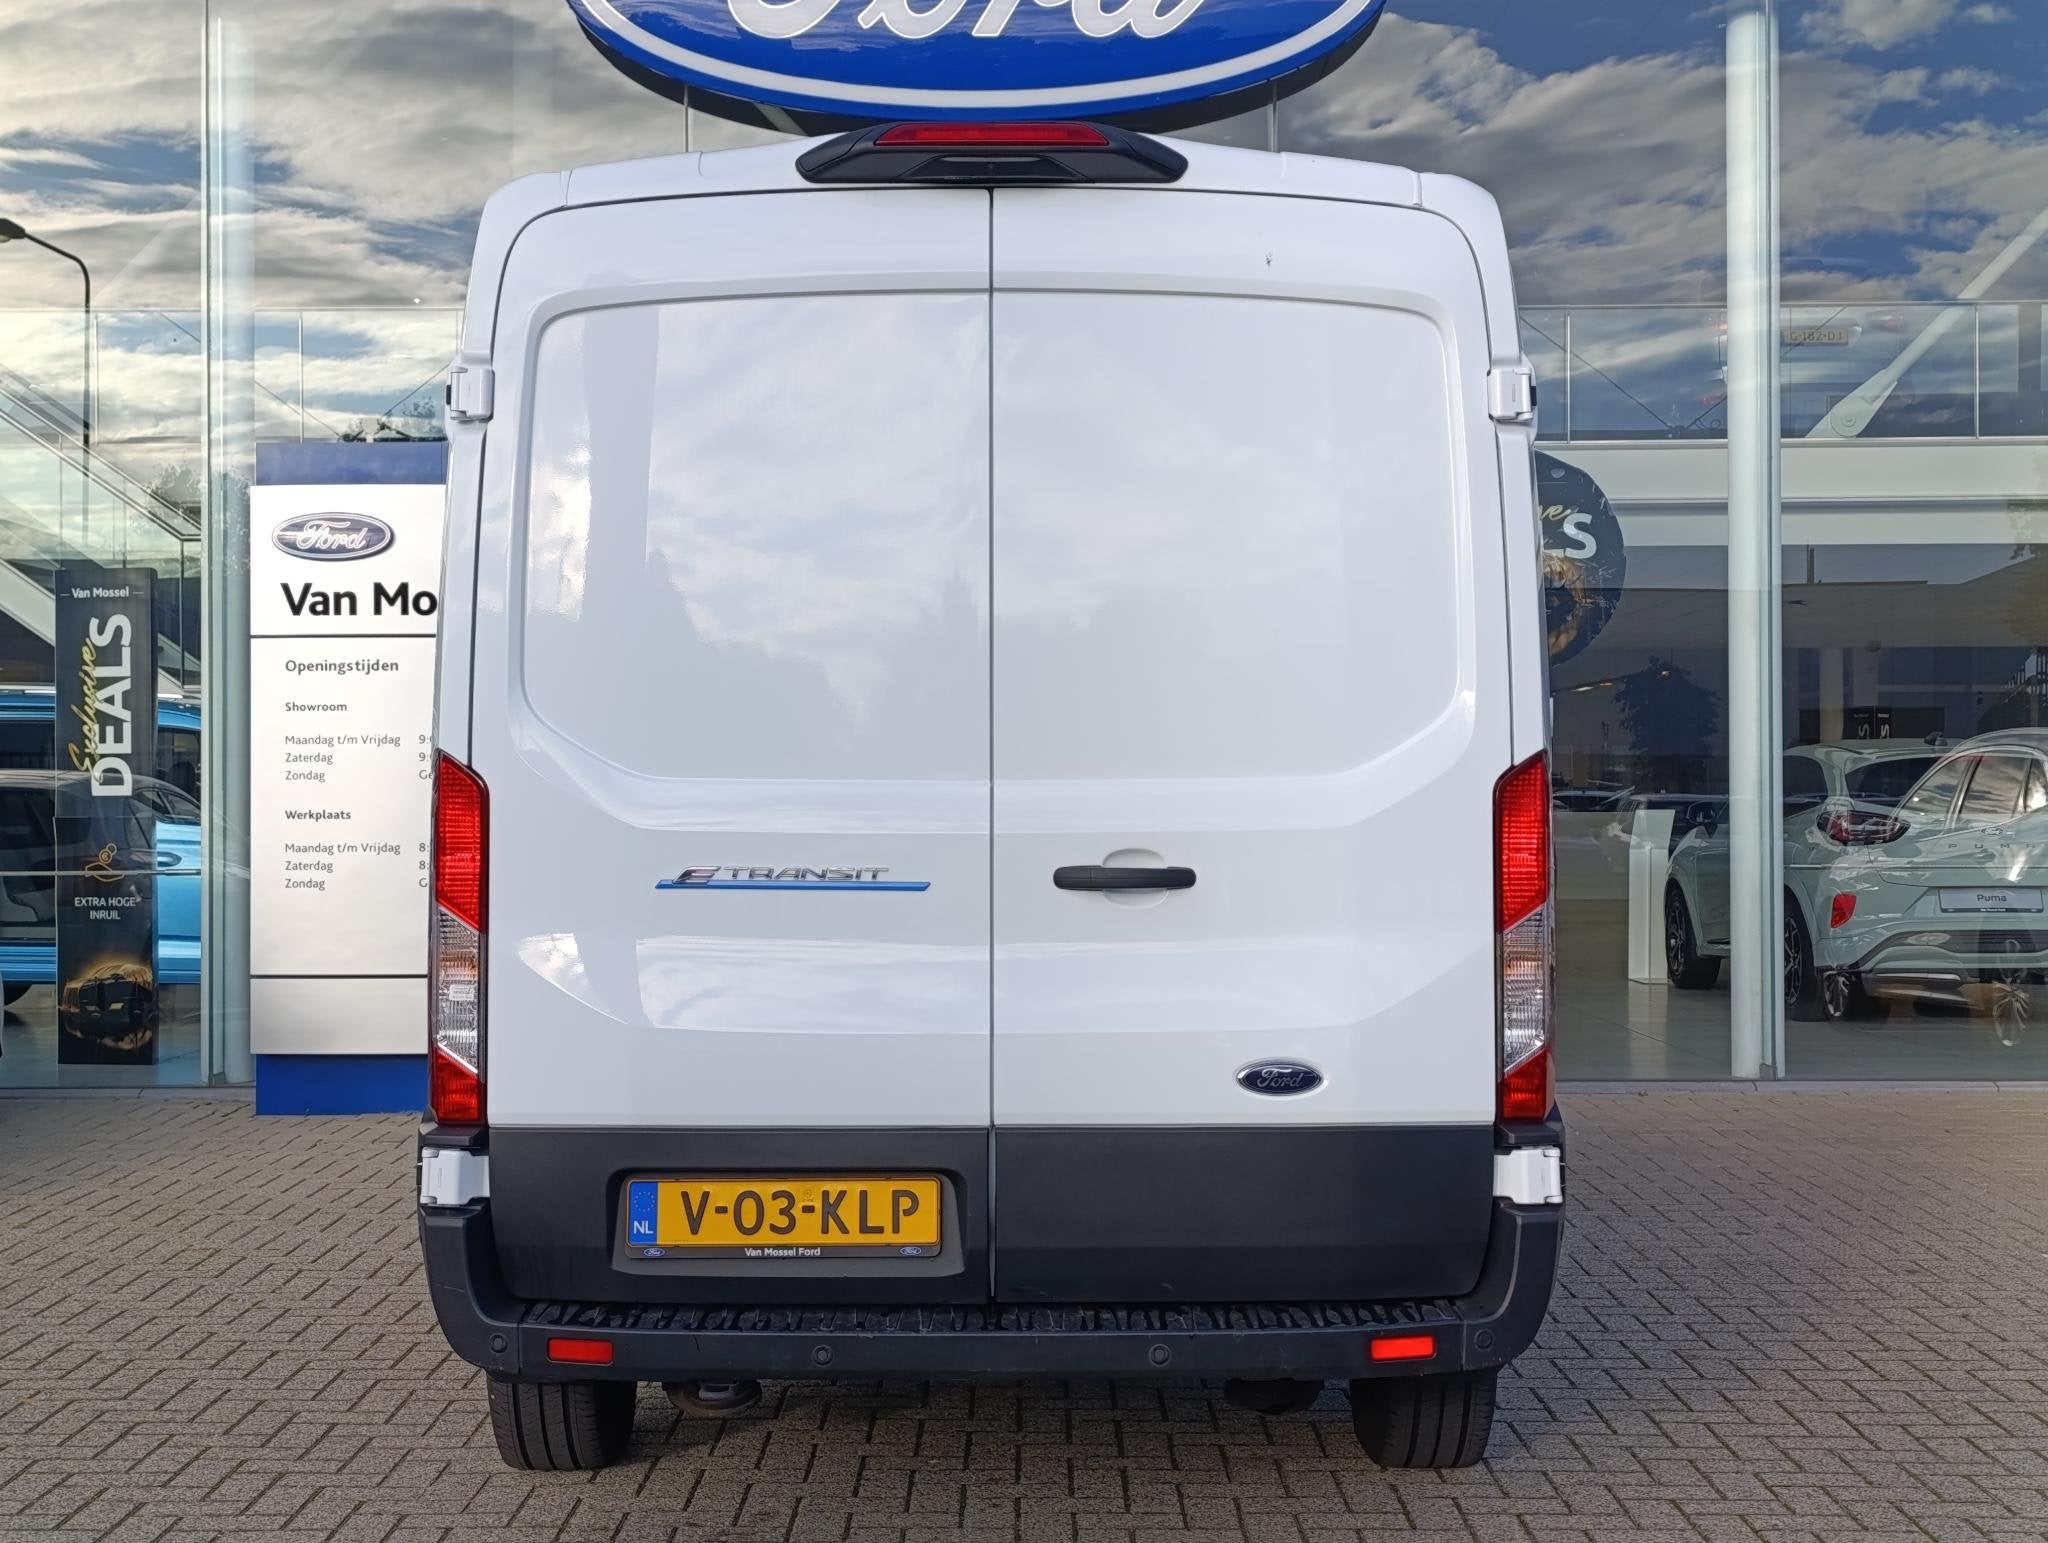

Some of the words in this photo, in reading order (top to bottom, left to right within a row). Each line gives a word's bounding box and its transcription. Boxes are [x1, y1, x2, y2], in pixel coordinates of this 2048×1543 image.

[296, 519, 369, 550] Ford
[71, 588, 91, 599] Van
[92, 586, 130, 598] Mossel
[280, 582, 358, 616] Van
[285, 659, 399, 675] Openingstijden
[68, 637, 103, 783] Exclusive
[88, 613, 133, 797] DEALS
[285, 702, 348, 712] Showroom
[285, 735, 334, 747] Maandag
[337, 735, 358, 745] t/m
[361, 735, 401, 747] Vrijdag
[285, 752, 333, 765] Zaterdag
[285, 770, 326, 783] Zondag
[285, 810, 351, 822] Werkplaats
[285, 843, 334, 856] Maandag
[337, 844, 358, 853] t/m
[361, 843, 401, 856] Vrijdag
[285, 860, 333, 873] Zaterdag
[723, 866, 889, 881] TRANSIT
[285, 878, 326, 891] Zondag
[74, 897, 107, 907] EXTRA
[108, 897, 136, 907] HOGE
[1976, 894, 2008, 903] Puma
[89, 910, 121, 920] INRUIL
[1256, 1068, 1305, 1088] Ford
[680, 1188, 920, 1236] V-03-KLP
[633, 1220, 654, 1235] NL
[744, 1248, 763, 1257] Van
[764, 1247, 797, 1257] Mossel
[798, 1247, 821, 1257] Ford
